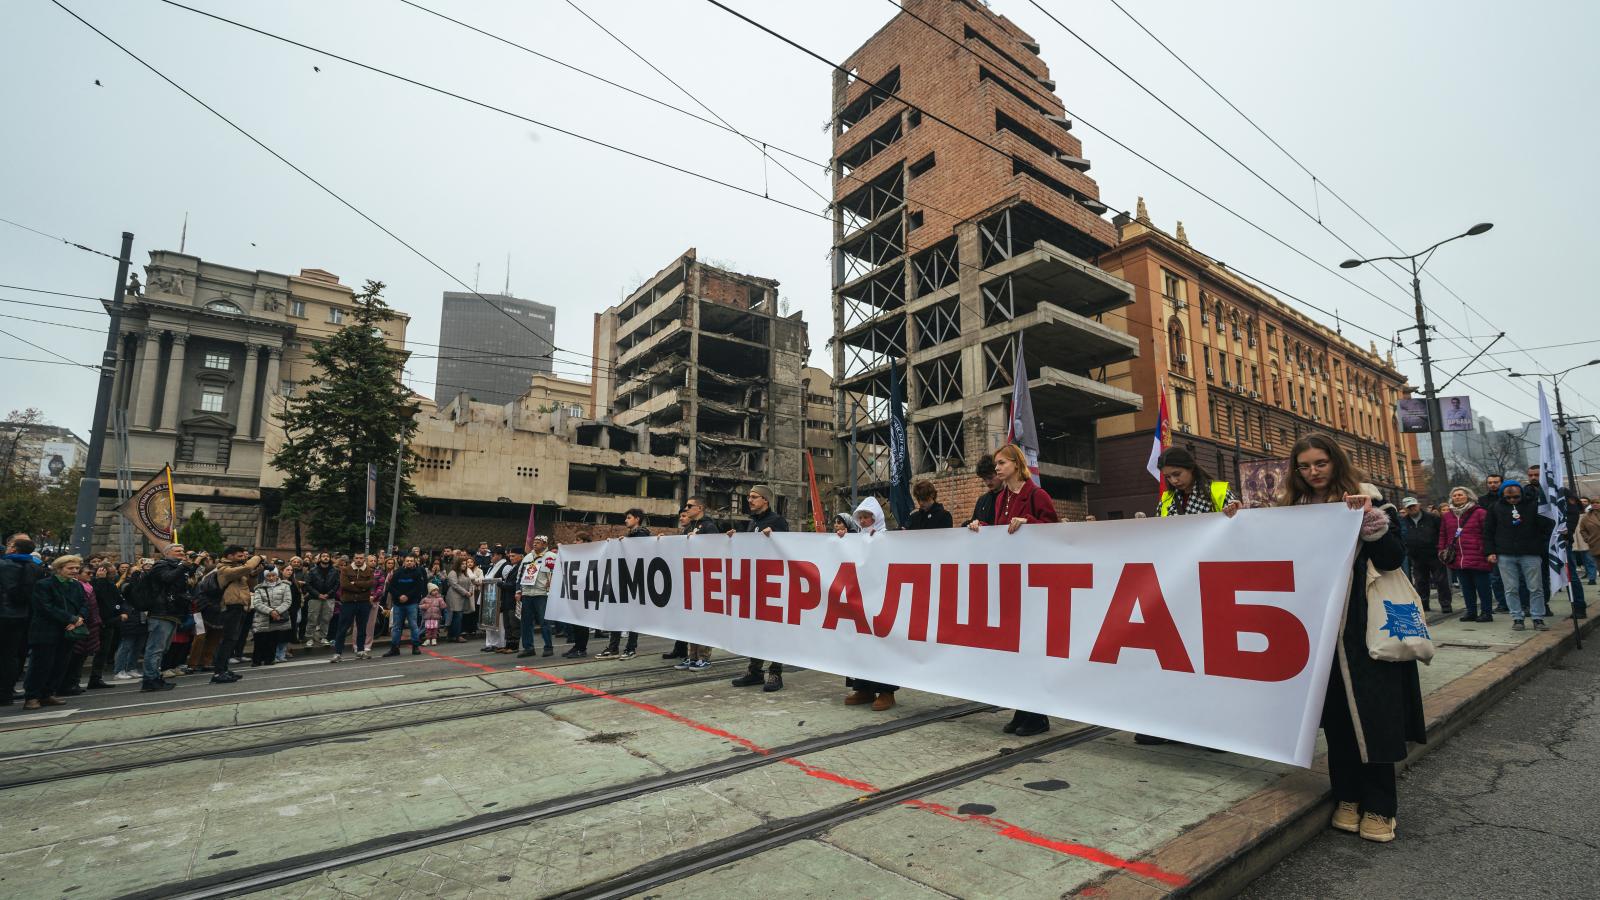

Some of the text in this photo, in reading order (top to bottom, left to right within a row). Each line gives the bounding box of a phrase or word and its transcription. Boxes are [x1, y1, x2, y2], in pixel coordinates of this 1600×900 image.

[560, 557, 1310, 682] НЕ ДАМО ГЕНЕРАЛШТАБ
